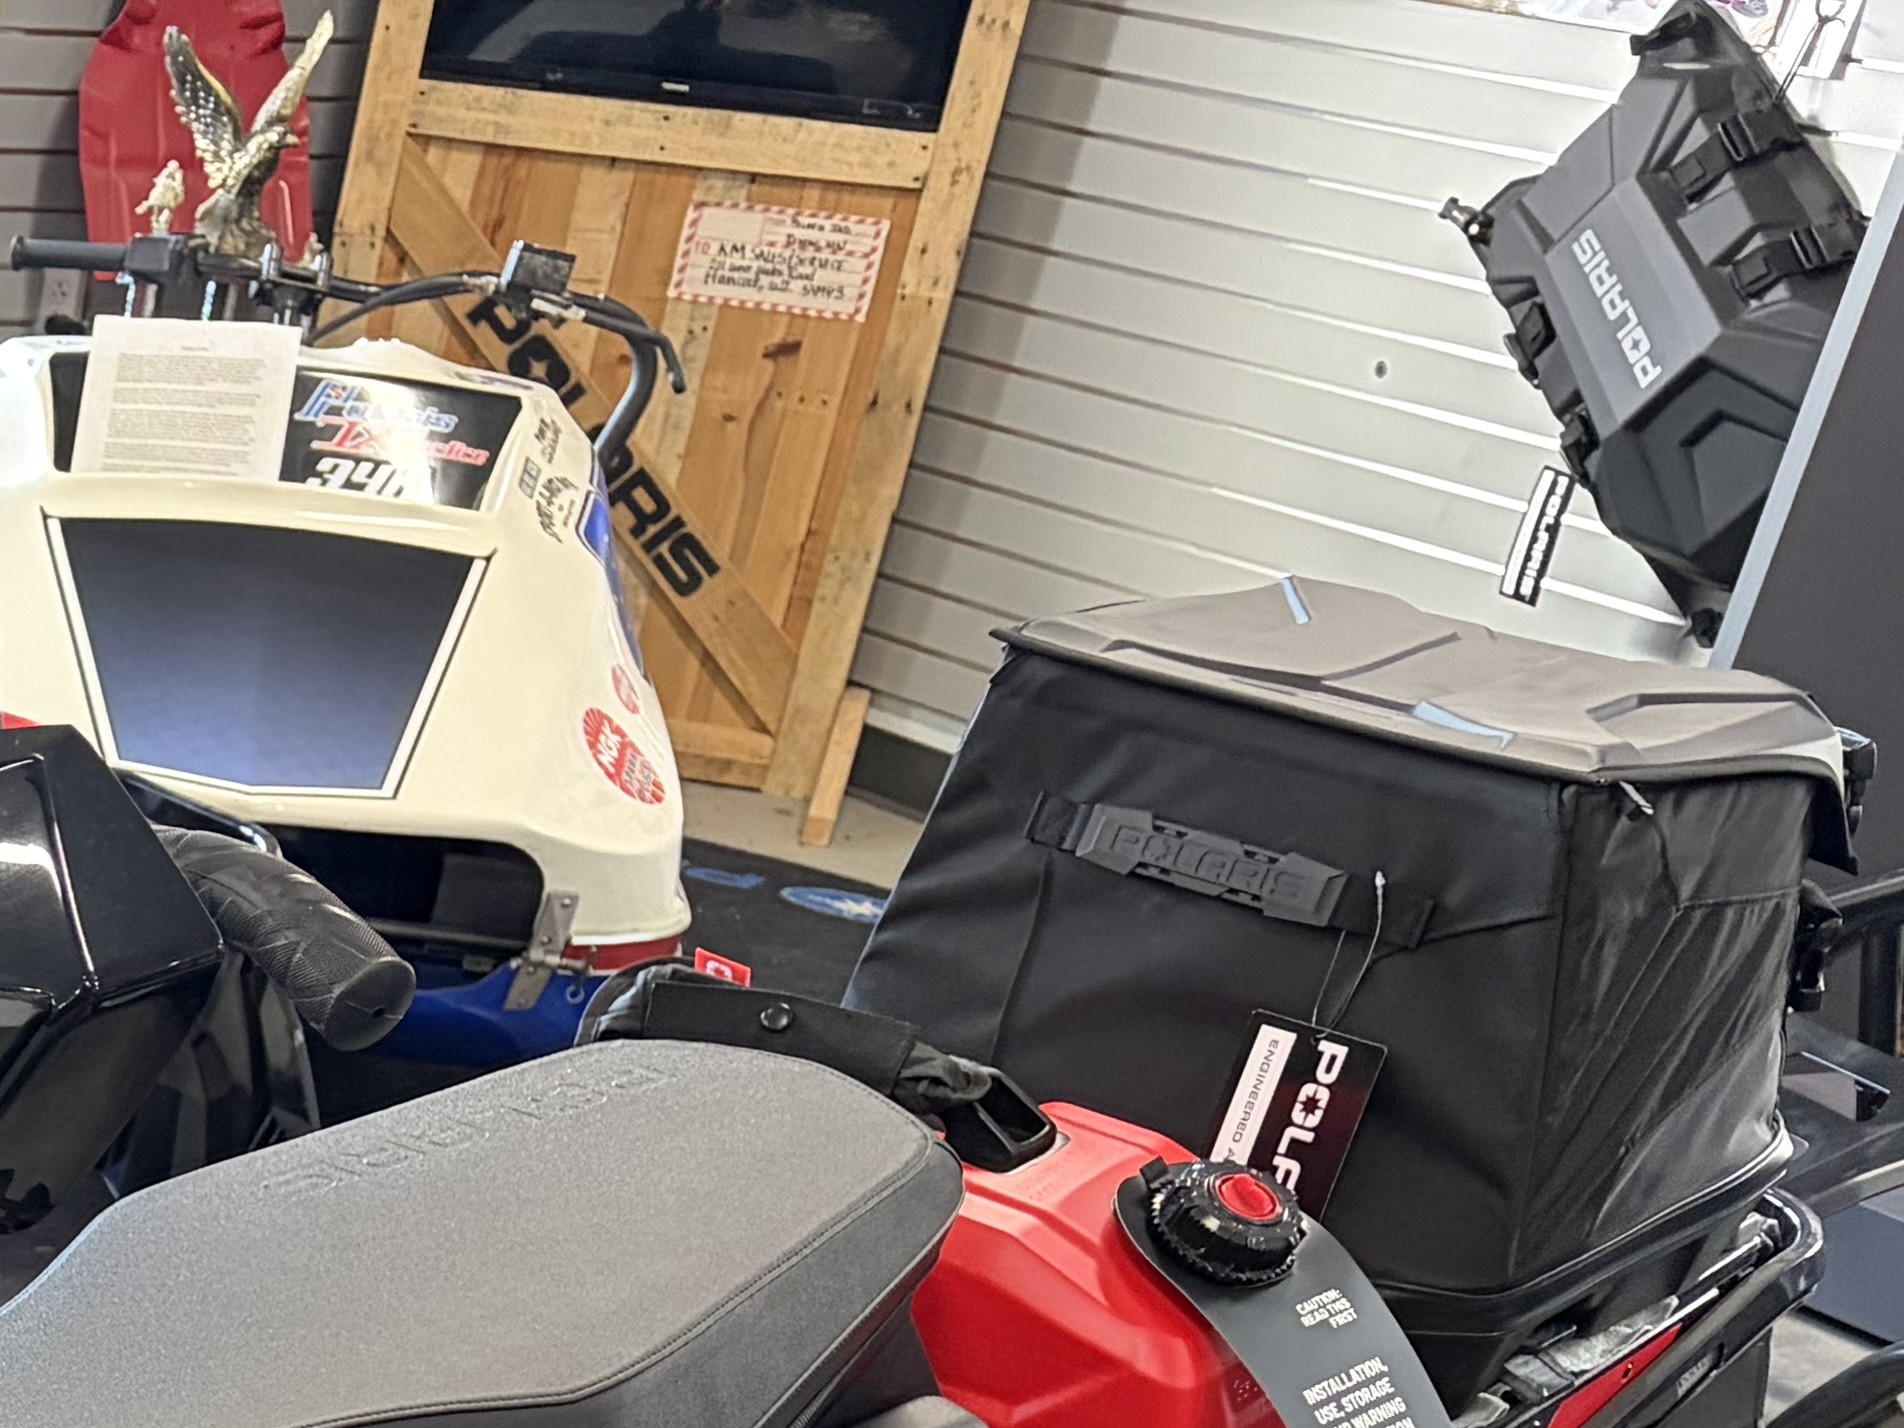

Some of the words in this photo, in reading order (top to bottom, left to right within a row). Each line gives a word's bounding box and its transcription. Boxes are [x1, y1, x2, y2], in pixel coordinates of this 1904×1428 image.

[1570, 227, 1664, 391] POLARIS
[1519, 473, 1571, 601] POLARIS
[597, 719, 623, 774] NGK
[1296, 1288, 1343, 1316] CAUTION:
[1329, 1308, 1358, 1329] FIRST
[1302, 1356, 1389, 1405] INSTALLATION,
[1314, 1404, 1346, 1425] USE,
[1341, 1376, 1395, 1413] STORAGE
